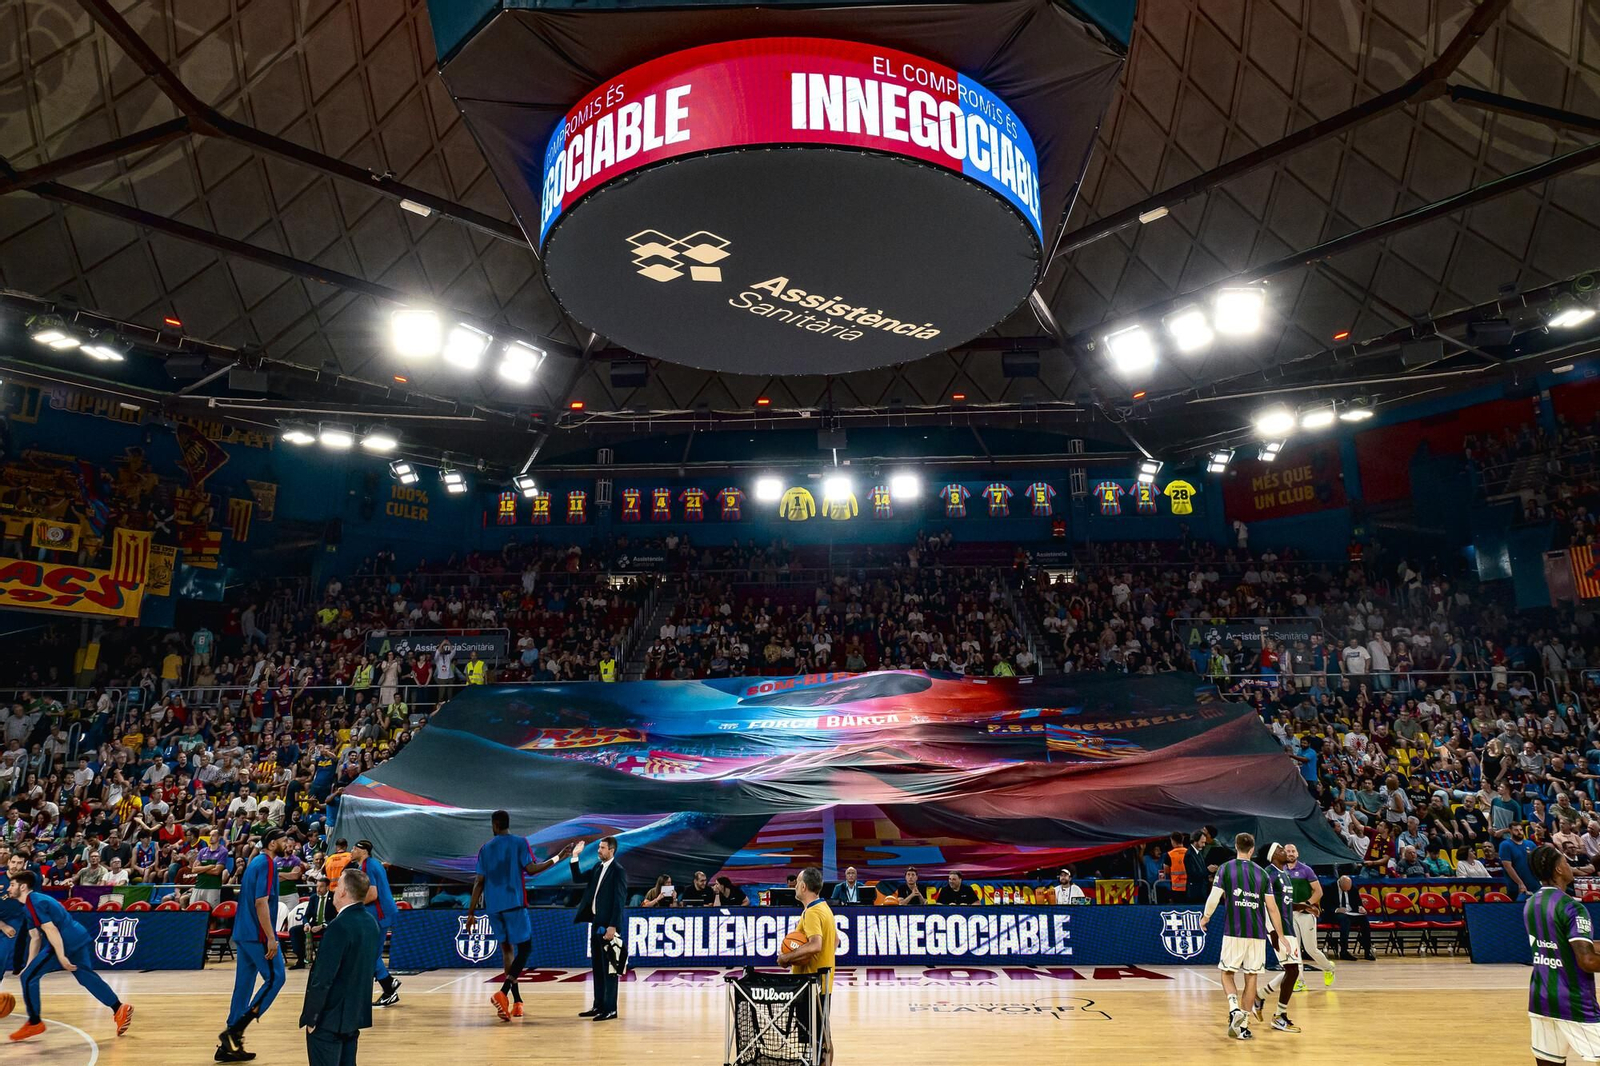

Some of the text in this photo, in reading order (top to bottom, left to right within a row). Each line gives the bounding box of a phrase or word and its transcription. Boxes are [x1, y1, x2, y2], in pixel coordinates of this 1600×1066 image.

[606, 84, 626, 108] ÉS
[873, 56, 897, 77] EL
[1005, 113, 1019, 140] ÉS
[751, 276, 941, 341] Assistència
[729, 291, 864, 342] Sanitària
[1252, 465, 1313, 492] MÉS QUE
[391, 484, 429, 505] 100%
[874, 494, 890, 505] 14
[950, 493, 959, 504] 8
[993, 492, 1002, 503] 7
[1037, 491, 1046, 502] 5
[1104, 490, 1114, 501] 4
[1140, 490, 1150, 501] 2
[1172, 490, 1189, 501] 28
[1254, 485, 1315, 511] UN CLUB
[500, 501, 514, 512] 15
[534, 501, 548, 511] 12
[570, 500, 583, 511] 11
[627, 498, 636, 508] 7
[656, 497, 666, 508] 4
[687, 496, 701, 507] 21
[726, 496, 735, 506] 9
[794, 496, 801, 506] 1
[385, 501, 429, 522] CULER
[295, 907, 304, 921] 5
[857, 914, 1074, 957] INNEGOCIABLE
[1533, 952, 1563, 969] álaga
[484, 965, 1174, 984] BARLONA
[751, 987, 794, 1001] Wilson
